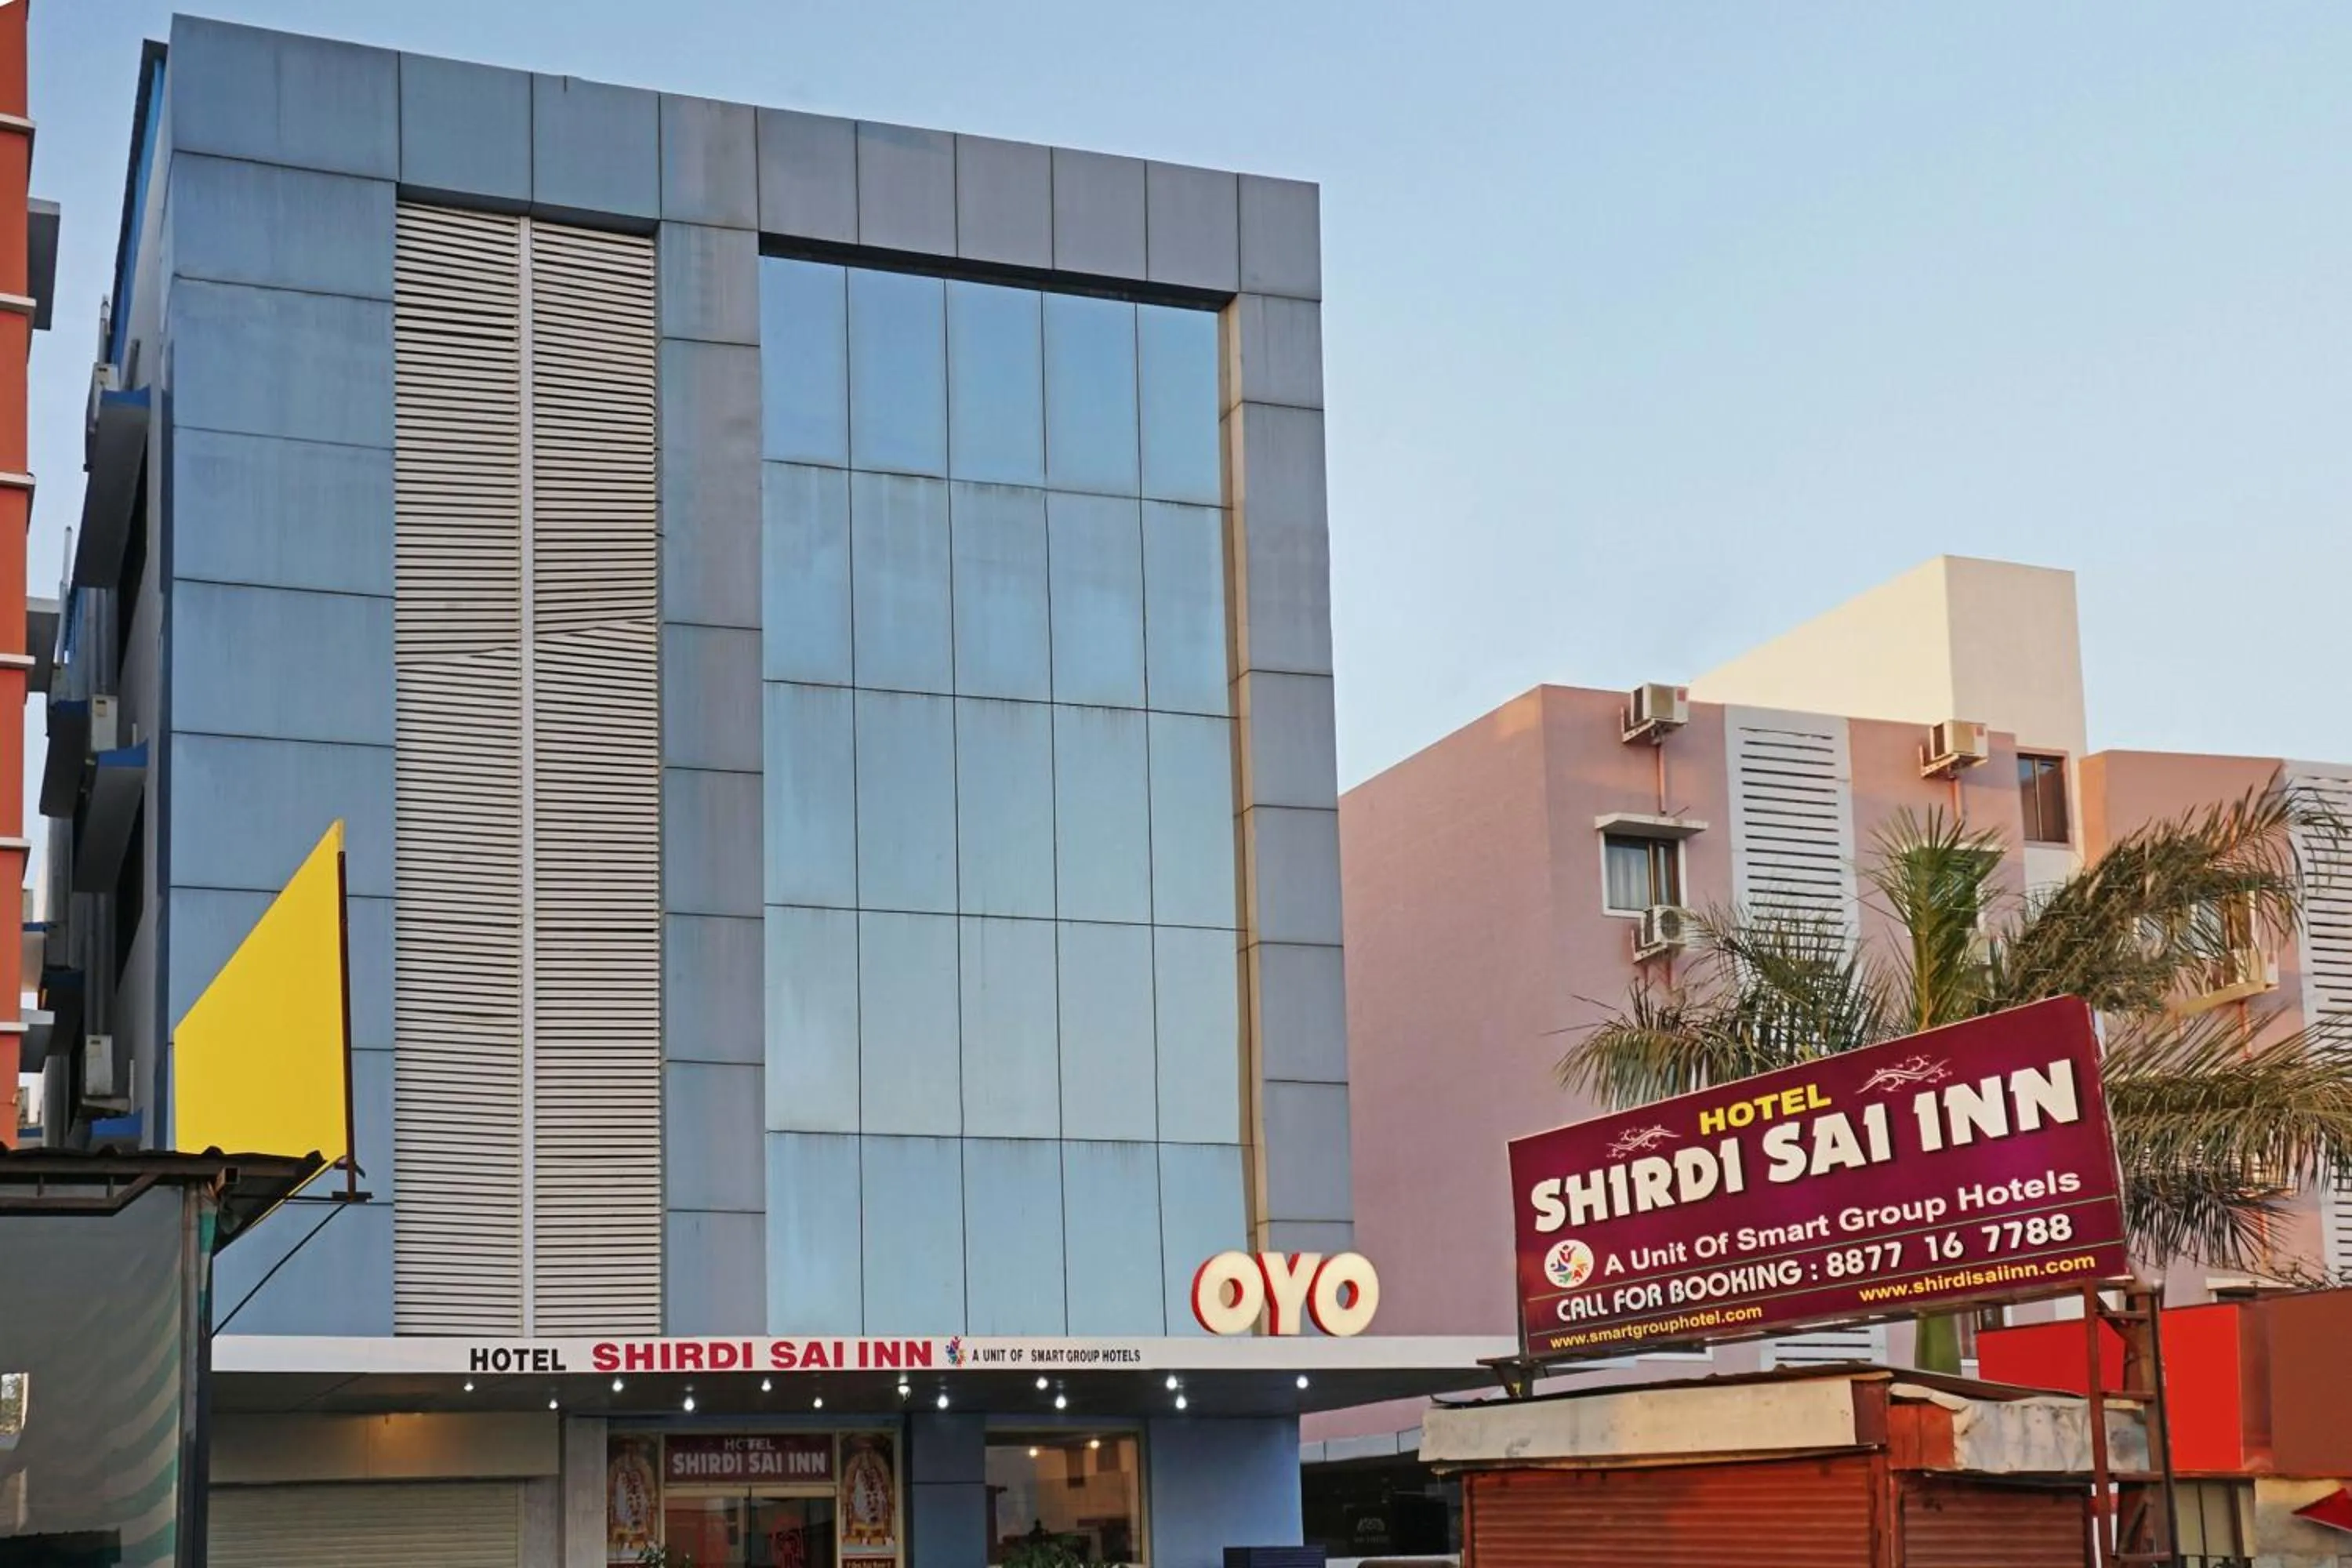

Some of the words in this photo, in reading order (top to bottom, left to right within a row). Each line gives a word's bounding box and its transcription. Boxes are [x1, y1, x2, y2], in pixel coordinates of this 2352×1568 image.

[1699, 1083, 1832, 1135] HOTEL
[1530, 1137, 1744, 1233] SHIRDI
[1762, 1102, 1893, 1182] SAI
[1913, 1058, 2079, 1152] INN
[1604, 1254, 1625, 1276] A
[1631, 1242, 1688, 1271] Unit
[1694, 1232, 1729, 1258] Of
[1737, 1214, 1831, 1251] Smart
[1838, 1196, 1947, 1232] Group
[1958, 1170, 2082, 1211] Hotels
[1556, 1294, 1610, 1322] CALL
[1613, 1283, 1663, 1313] FOR
[1669, 1259, 1802, 1305] BOOKING
[1826, 1241, 1903, 1278] 8877
[1925, 1231, 1965, 1262] 16
[1981, 1214, 2073, 1253] 7788
[1859, 1254, 2096, 1303] www.shirdisaiinn.com
[1190, 1250, 1380, 1338] OYO
[1549, 1305, 1762, 1350] www.smartgrouphotel.com
[470, 1347, 567, 1372] HOTEL
[592, 1341, 753, 1371] SHIRDI
[770, 1340, 844, 1370] SAI
[858, 1340, 933, 1368] INN
[971, 1348, 980, 1363] A
[983, 1348, 1007, 1363] UNIT
[1011, 1348, 1023, 1363] OF
[1031, 1348, 1065, 1363] SMART
[1066, 1348, 1100, 1363] GROUP
[1102, 1348, 1142, 1363] HOTELS
[672, 1451, 742, 1475] SHIRDI
[747, 1451, 783, 1474] SAI
[787, 1451, 827, 1474] INN
[724, 1437, 776, 1451] HOTEL
